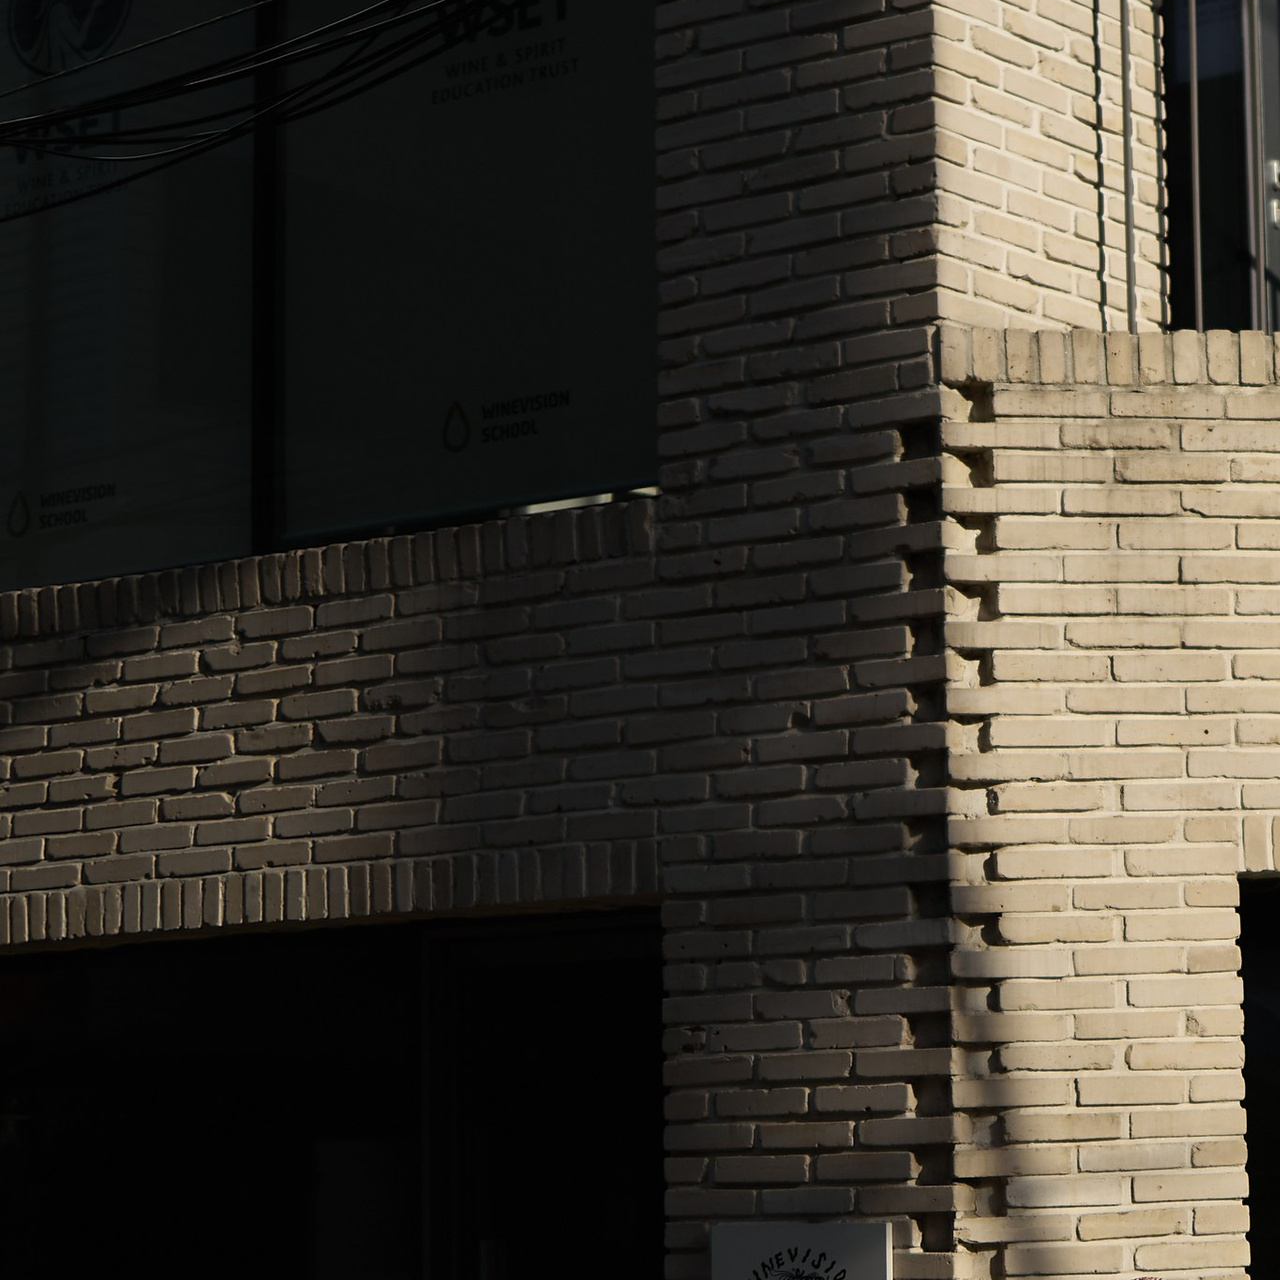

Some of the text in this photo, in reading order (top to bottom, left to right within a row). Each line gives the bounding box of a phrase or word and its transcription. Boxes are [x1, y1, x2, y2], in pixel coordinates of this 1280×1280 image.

[445, 38, 566, 79] WINE & SPIRIT
[431, 58, 580, 104] EDUCATION TRUST
[481, 390, 571, 419] WINEVISION
[481, 419, 539, 443] SCHOOL
[39, 483, 116, 508] WINEVISION
[39, 509, 89, 529] SCHOOL
